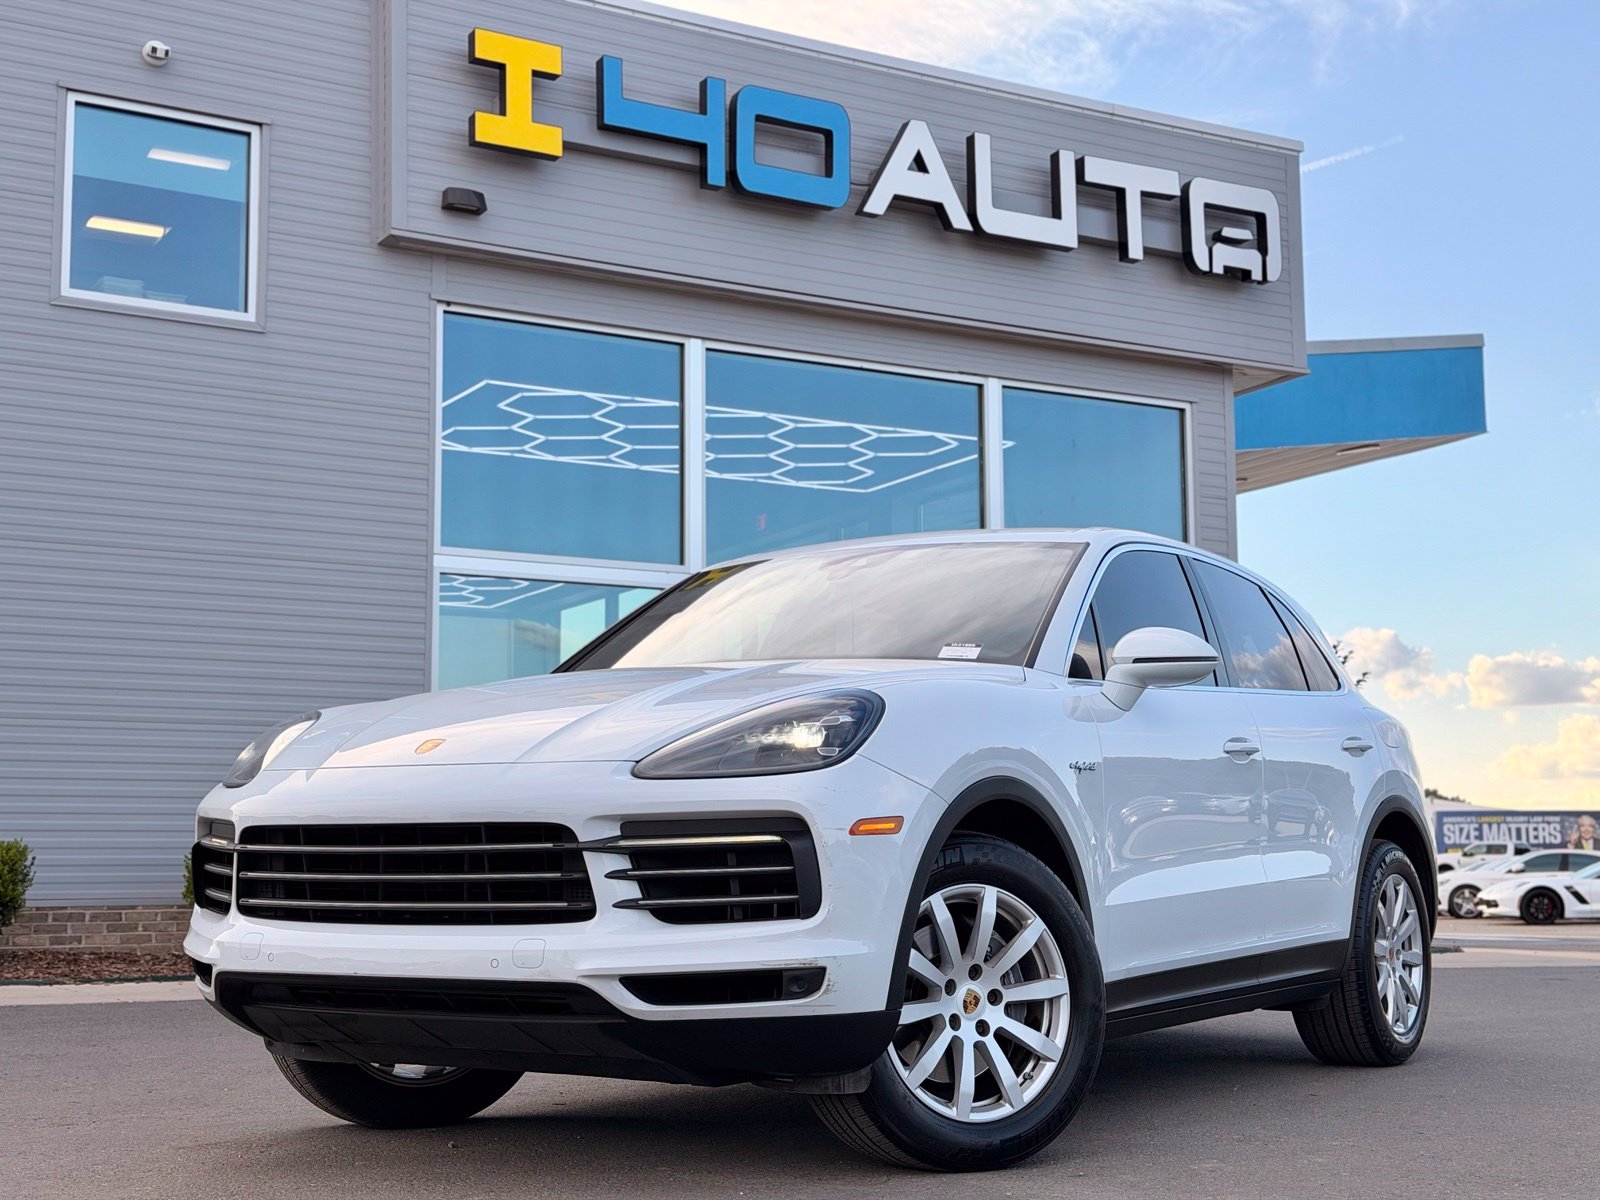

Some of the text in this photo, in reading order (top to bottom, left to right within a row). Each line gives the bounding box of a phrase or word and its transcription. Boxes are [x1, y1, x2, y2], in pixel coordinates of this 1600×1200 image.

[857, 118, 1283, 285] AUTO
[1443, 823, 1562, 844] SIZE MATTERS
